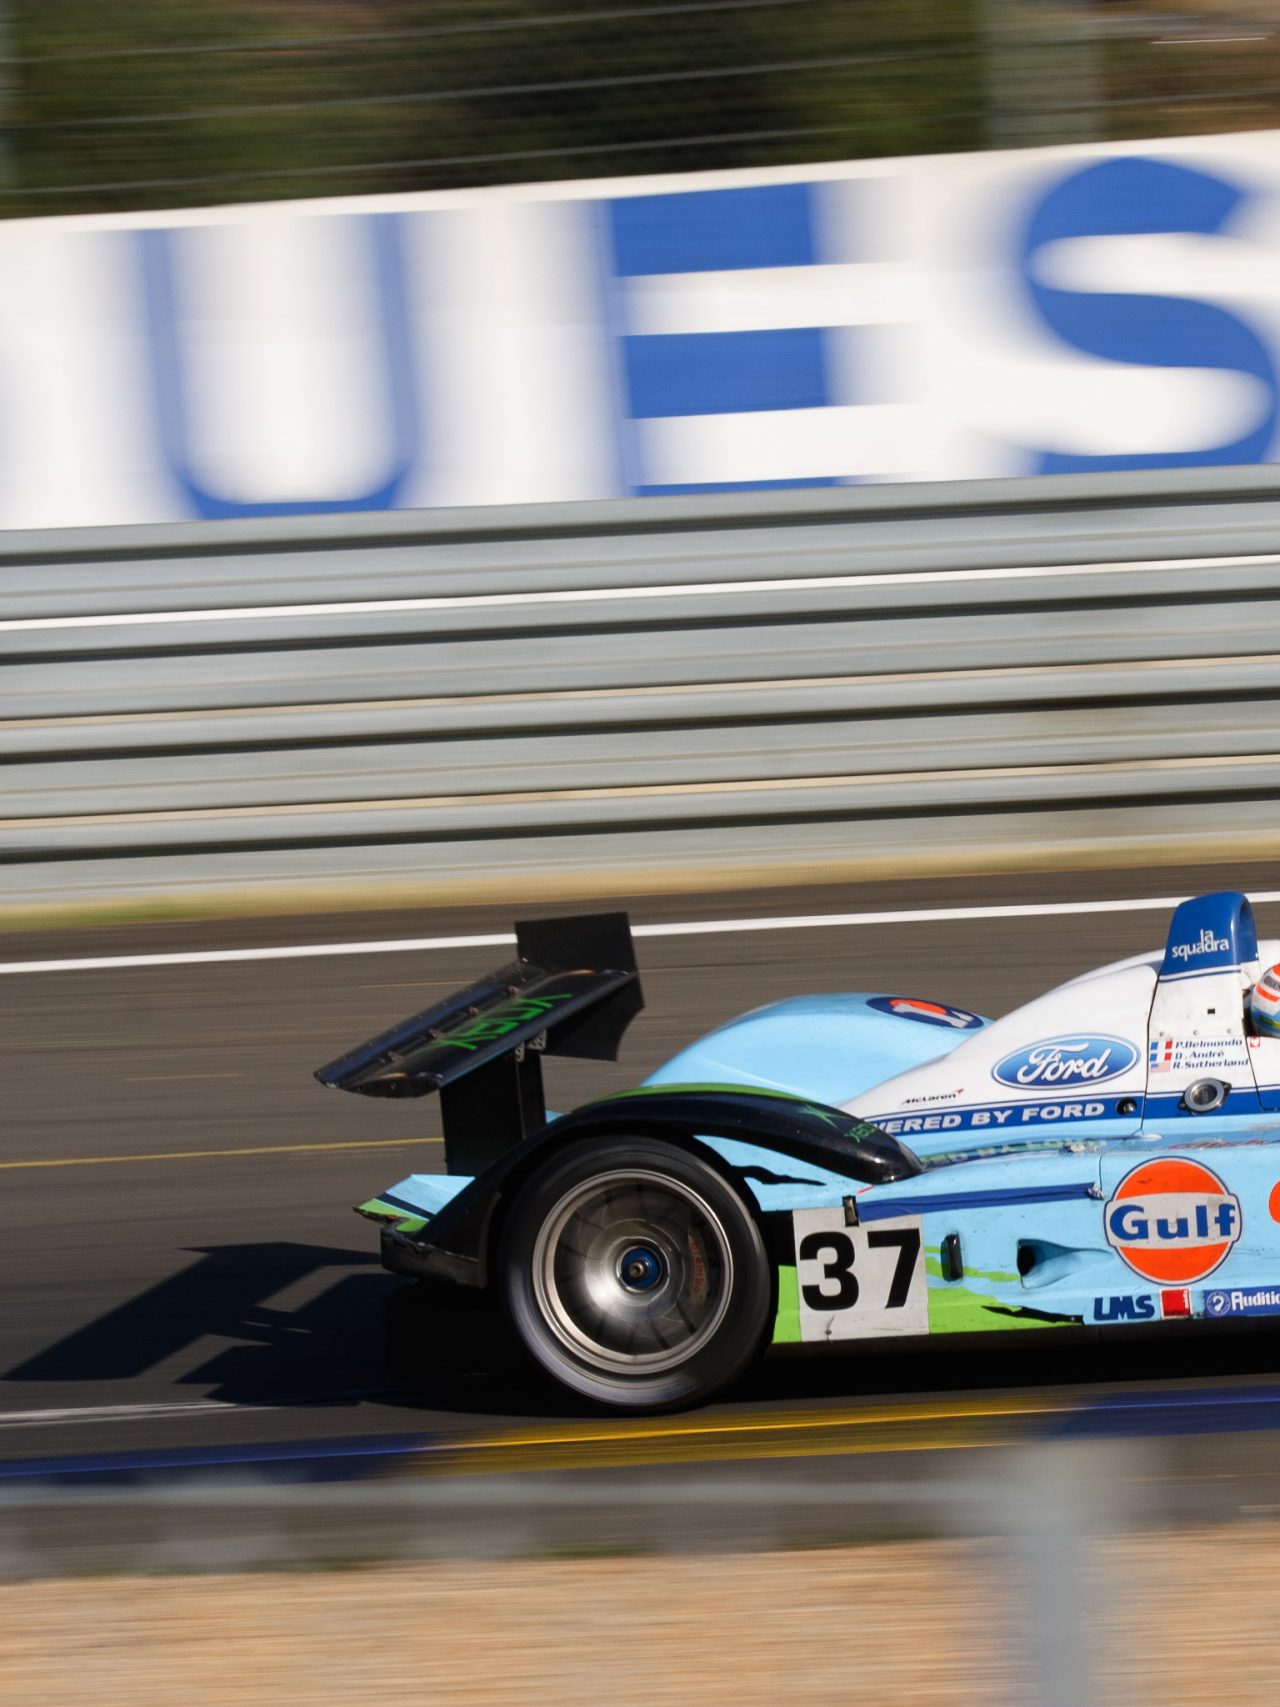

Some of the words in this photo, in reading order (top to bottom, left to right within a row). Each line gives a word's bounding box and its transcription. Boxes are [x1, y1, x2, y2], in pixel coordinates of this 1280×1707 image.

[1172, 937, 1230, 962] squadra
[1016, 1042, 1113, 1084] Ford
[1190, 1049, 1225, 1059] André
[971, 1109, 1014, 1126] BY
[1021, 1102, 1105, 1121] FORD
[1109, 1203, 1236, 1241] Gulf
[799, 1227, 921, 1312] 37
[1094, 1294, 1156, 1321] LMS
